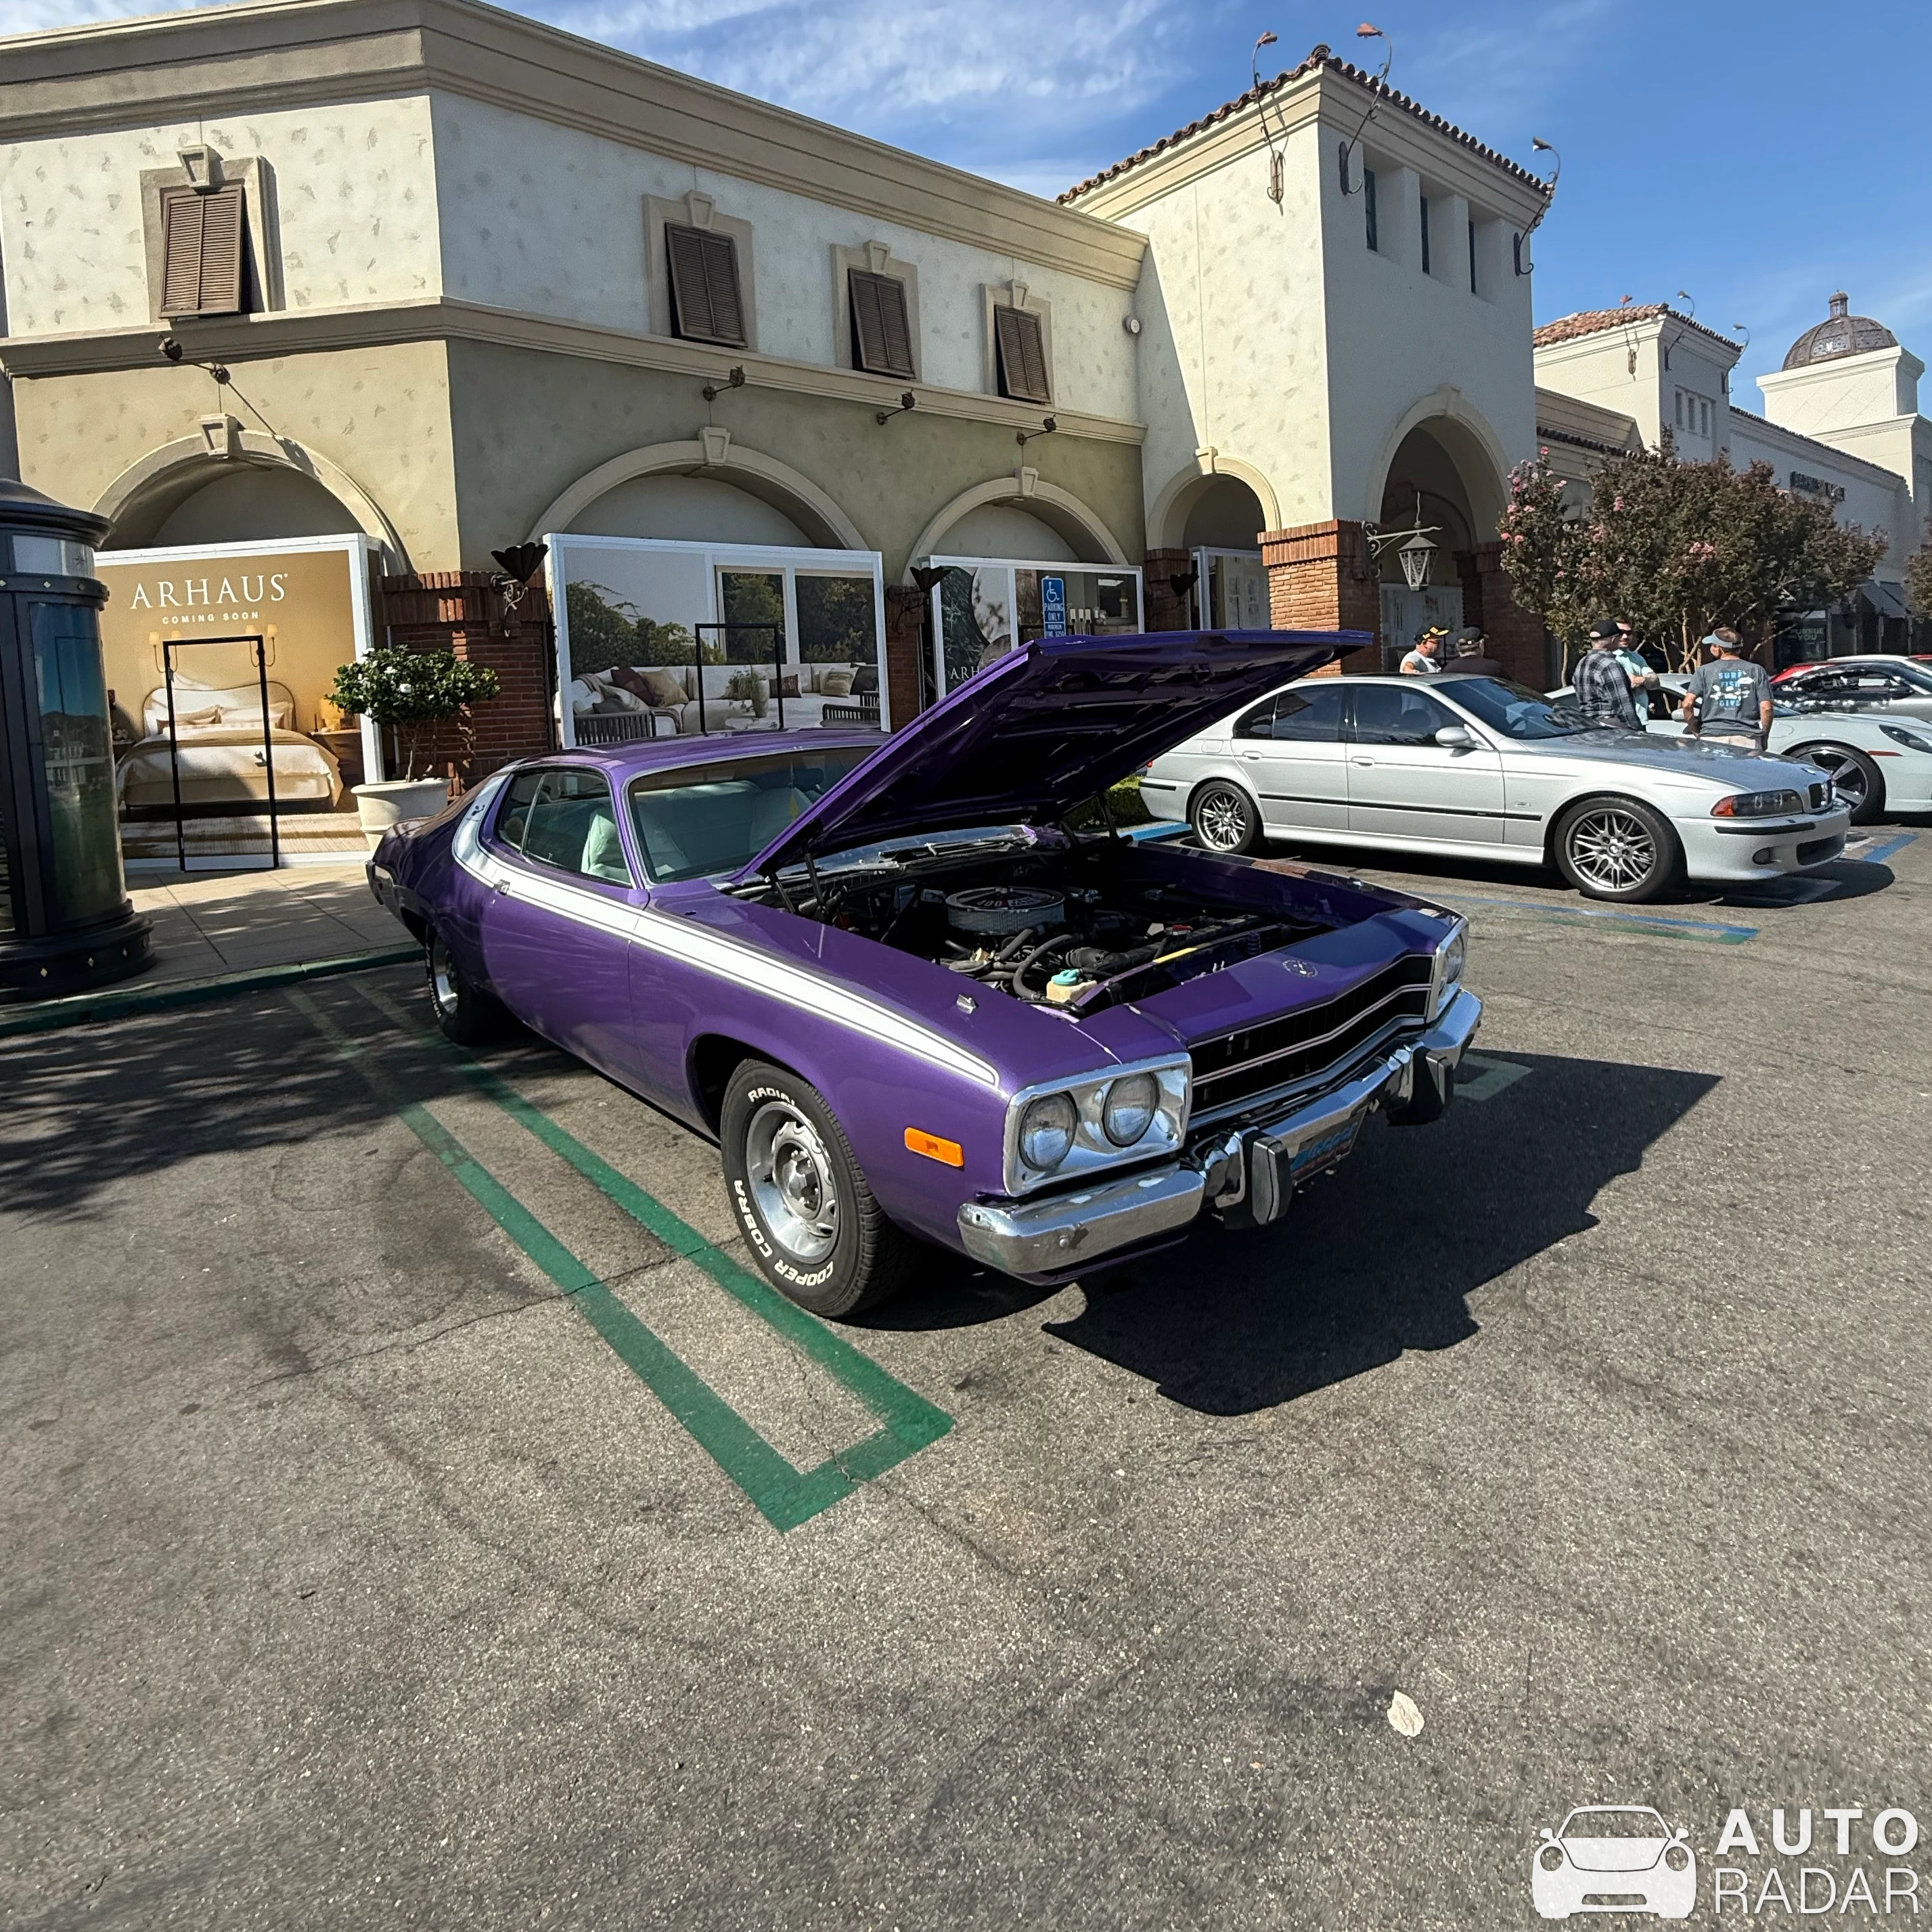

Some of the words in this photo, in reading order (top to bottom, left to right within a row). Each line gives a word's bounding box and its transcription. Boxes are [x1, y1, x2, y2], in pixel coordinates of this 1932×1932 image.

[130, 574, 285, 609] ARHAUS
[1043, 603, 1064, 611] PARKING
[162, 614, 215, 625] COMING
[223, 612, 259, 620] SOON
[1048, 612, 1060, 621] ONLY
[1719, 671, 1743, 679] SURF
[734, 1180, 773, 1258] COBRA
[774, 1259, 834, 1286] COOPER
